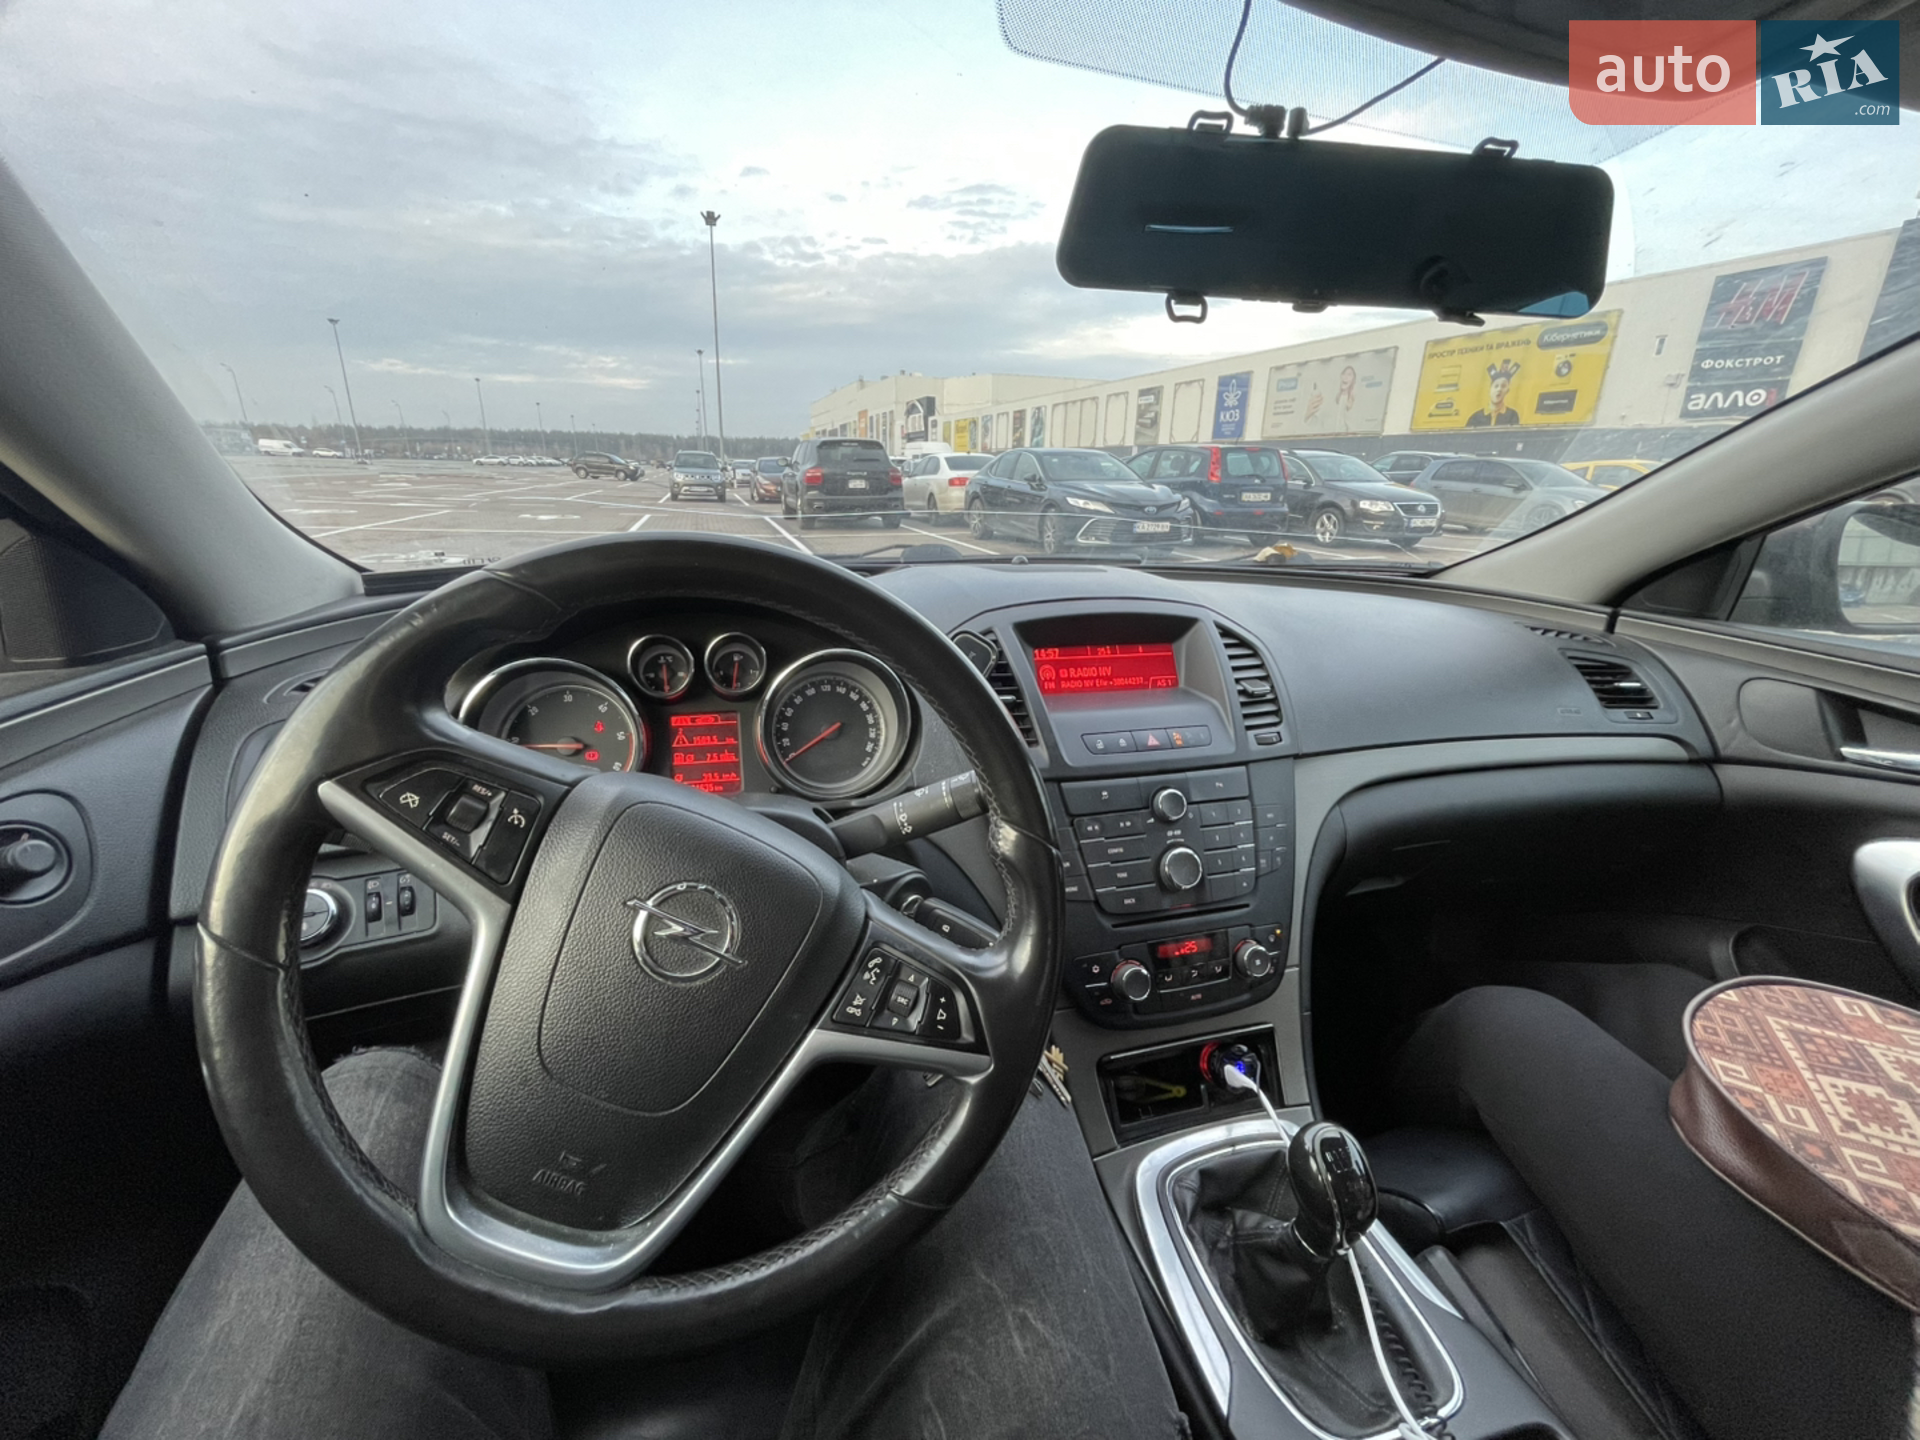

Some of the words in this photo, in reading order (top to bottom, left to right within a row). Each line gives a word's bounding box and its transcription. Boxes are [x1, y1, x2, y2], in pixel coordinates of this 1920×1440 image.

[1714, 270, 1809, 329] H&M
[1700, 354, 1785, 369] ФОКСТРОТ
[1069, 667, 1098, 678] RADIO
[1061, 680, 1083, 689] RADIO
[1156, 679, 1167, 687] AS
[563, 694, 573, 703] 30
[528, 706, 539, 716] 20
[597, 703, 608, 713] 40
[616, 731, 626, 741] 50
[612, 762, 622, 771] 60
[532, 1169, 588, 1195] AIRBAG
